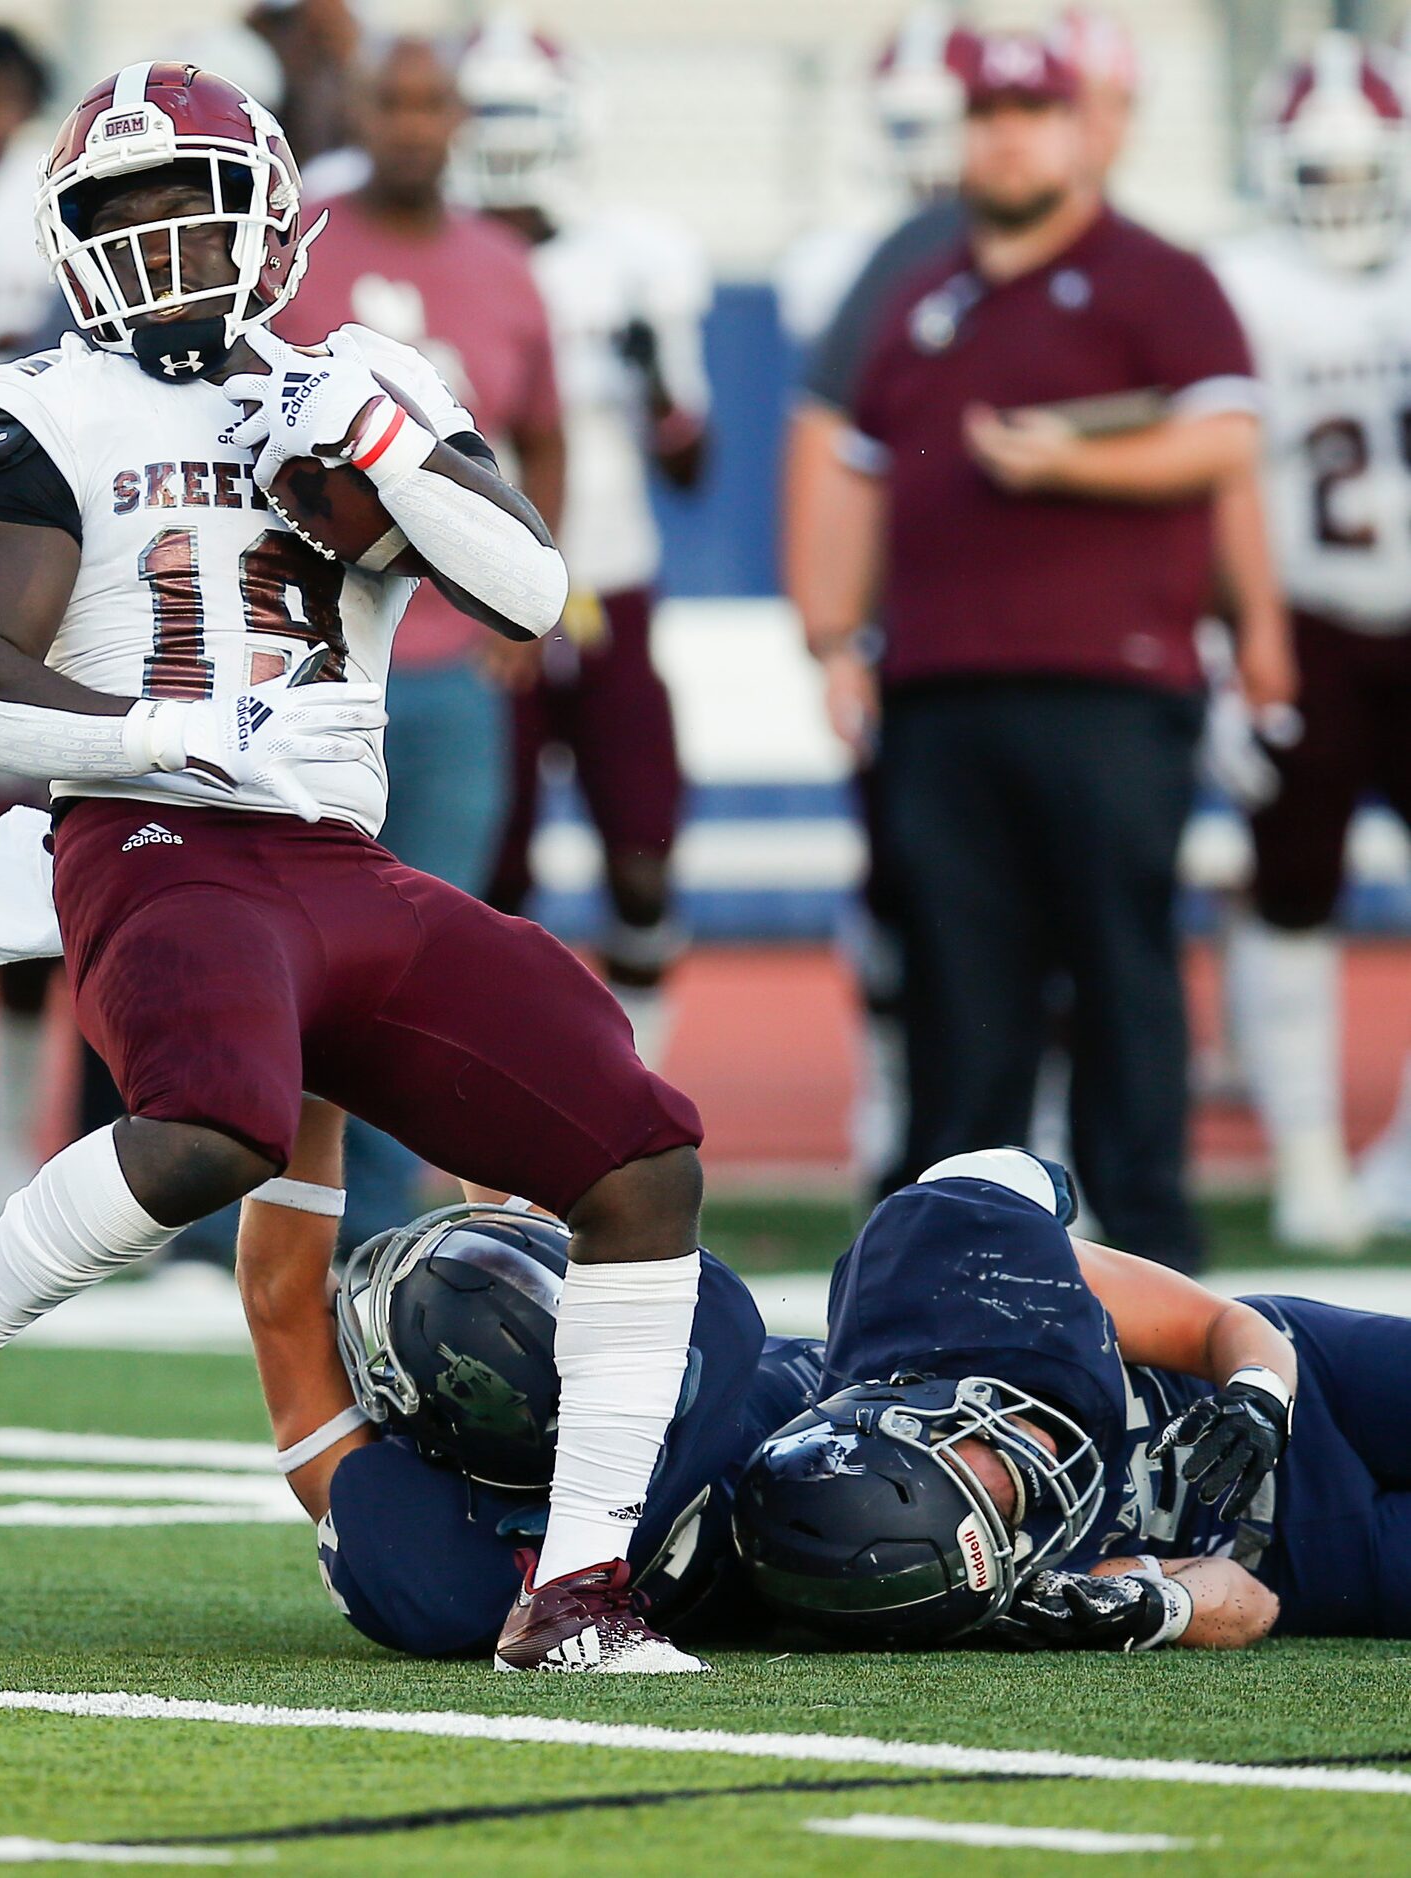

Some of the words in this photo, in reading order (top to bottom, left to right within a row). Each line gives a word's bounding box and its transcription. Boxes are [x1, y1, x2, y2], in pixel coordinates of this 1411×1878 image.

[105, 117, 144, 137] DFAM
[286, 371, 330, 427] adidas
[113, 461, 270, 515] SKEET
[236, 695, 250, 751] adidas
[121, 832, 183, 852] adidas
[964, 1530, 987, 1588] Riddell
